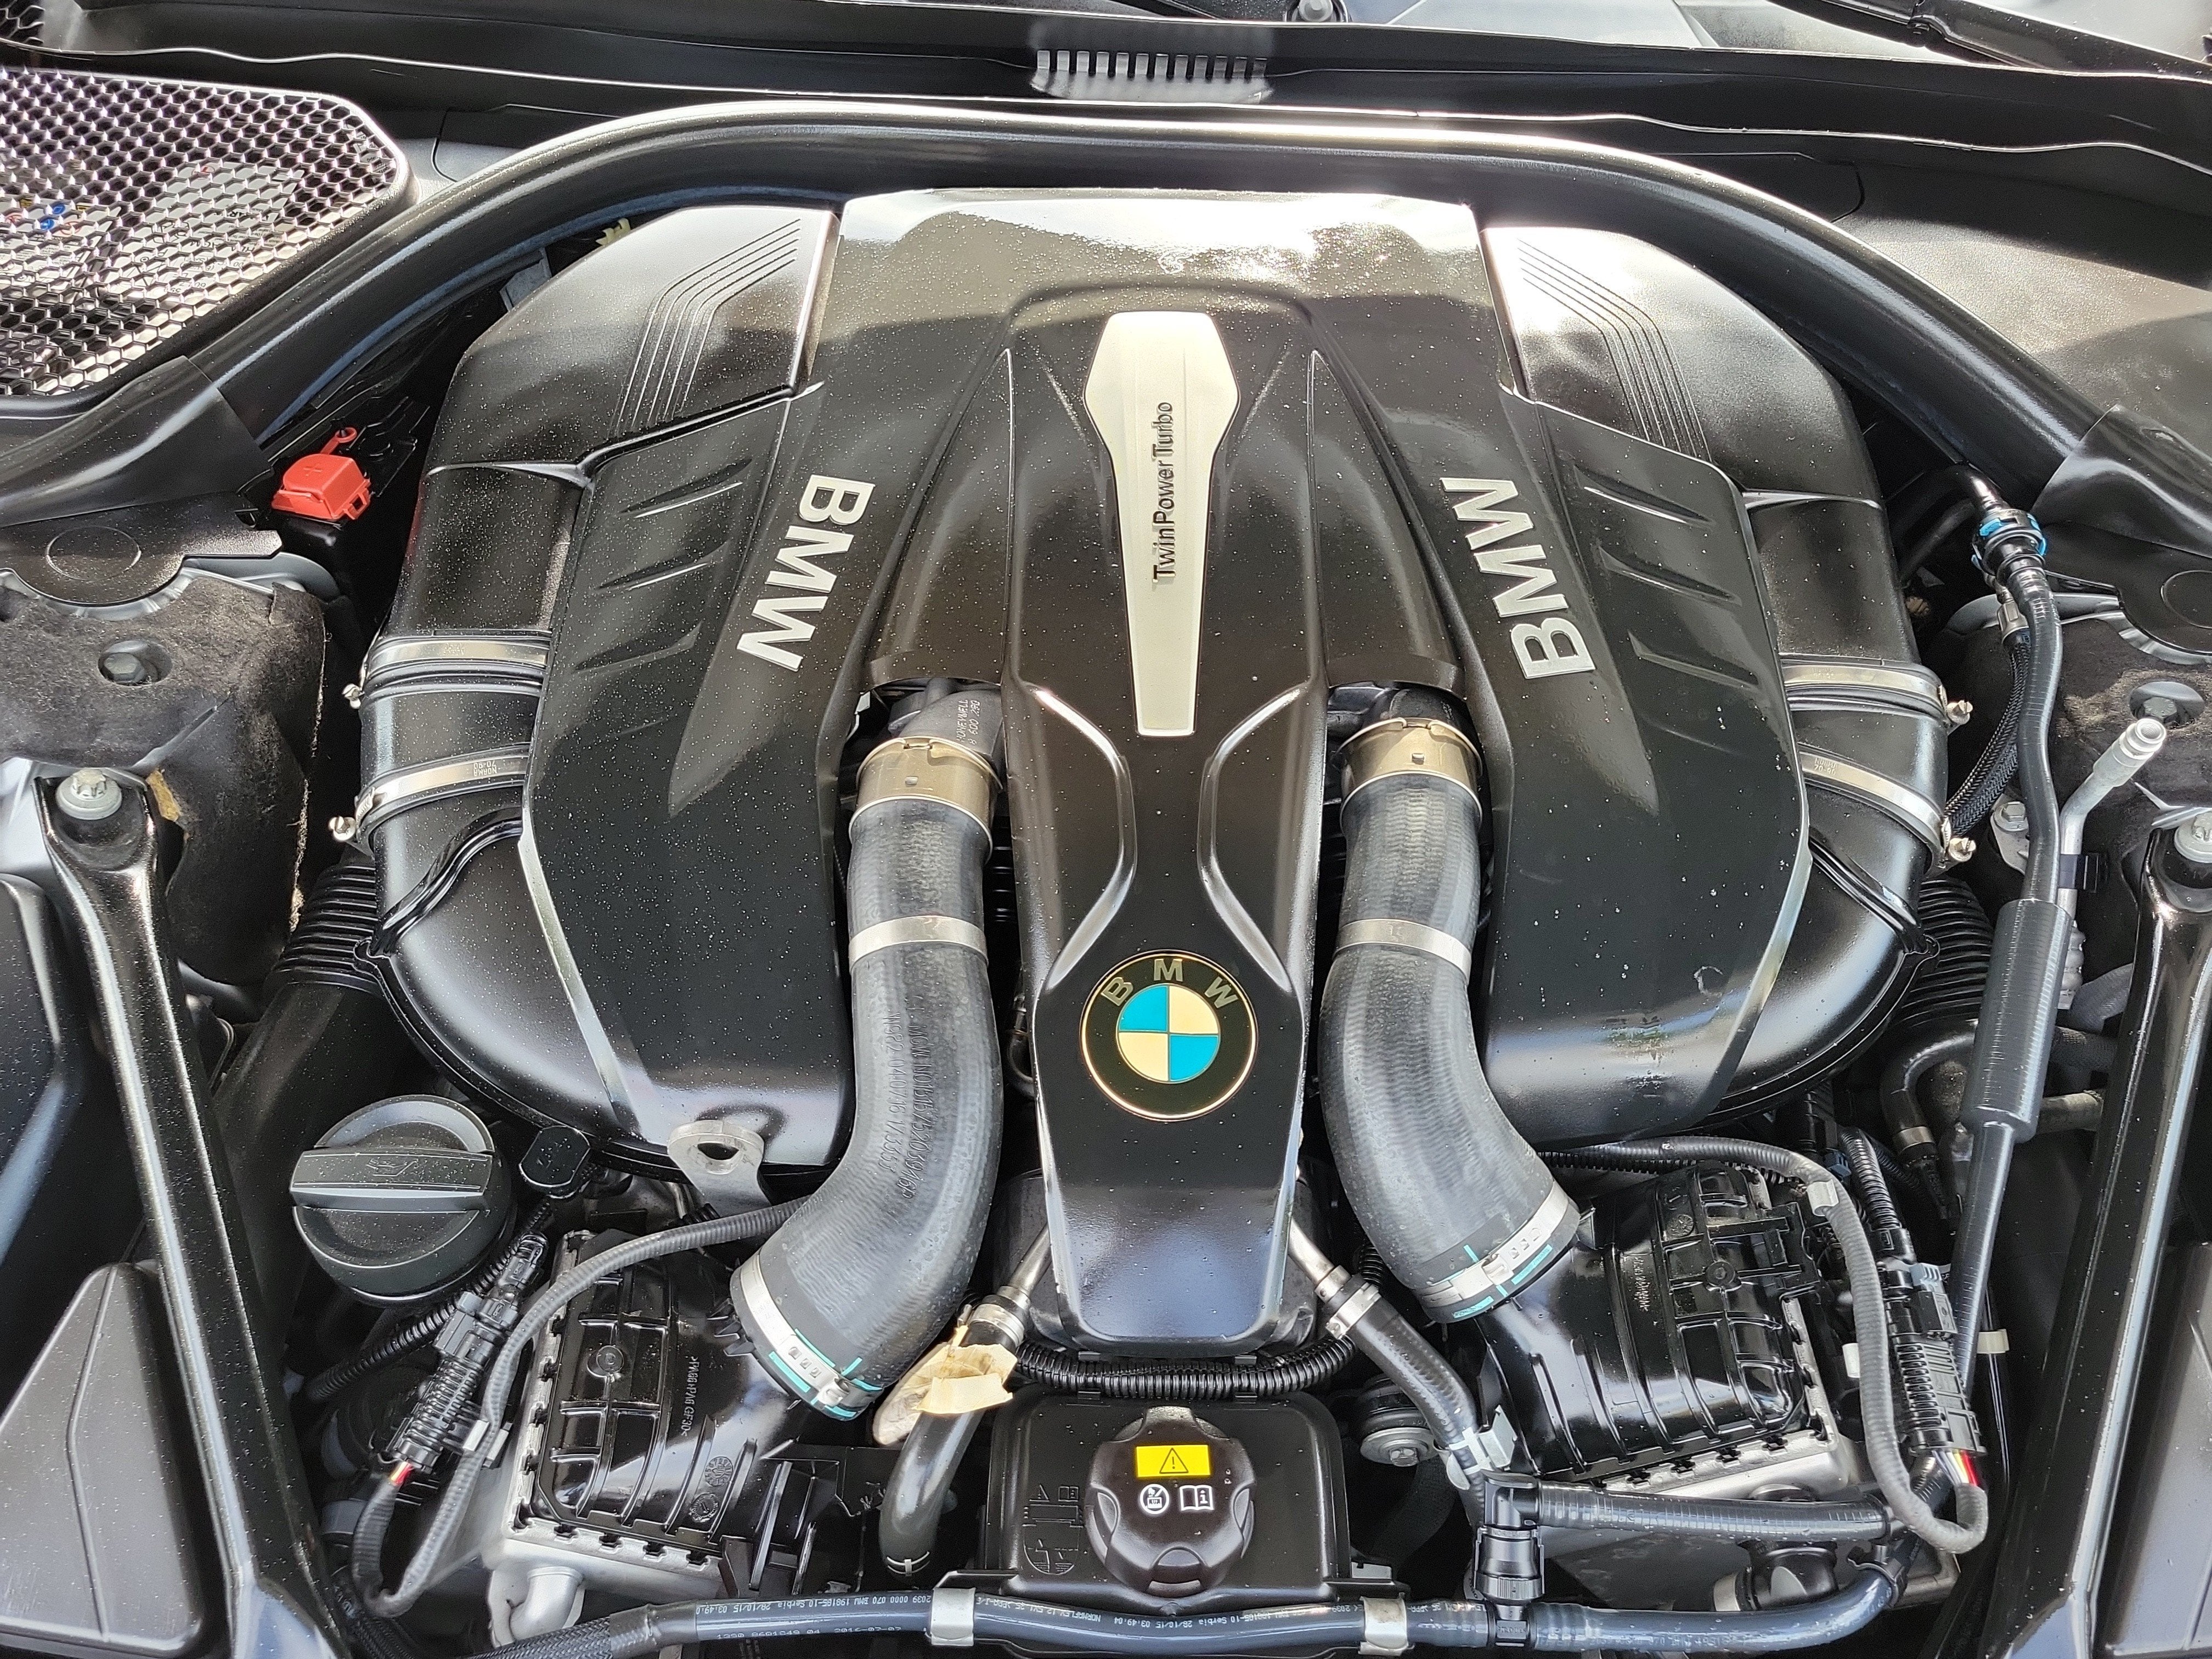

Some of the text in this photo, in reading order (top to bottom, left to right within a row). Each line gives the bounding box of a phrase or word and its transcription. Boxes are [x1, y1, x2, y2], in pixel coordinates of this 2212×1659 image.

[1151, 402, 1176, 583] TwinPower Turbo
[737, 474, 876, 672] BMW
[1440, 477, 1595, 679] BMW
[956, 699, 968, 743] HONEYWELL
[968, 718, 979, 735] 600
[473, 760, 496, 769] 70-90
[1814, 764, 1836, 776] 70-90
[473, 766, 497, 777] NORMA
[1099, 957, 1237, 1009] BMW
[778, 1600, 805, 1610] Serbia
[854, 1596, 869, 1605] BMW
[872, 1596, 886, 1604] 070
[890, 1595, 909, 1604] 0000
[733, 1603, 771, 1613] 28/10/15
[1198, 1616, 1227, 1626] Serbia
